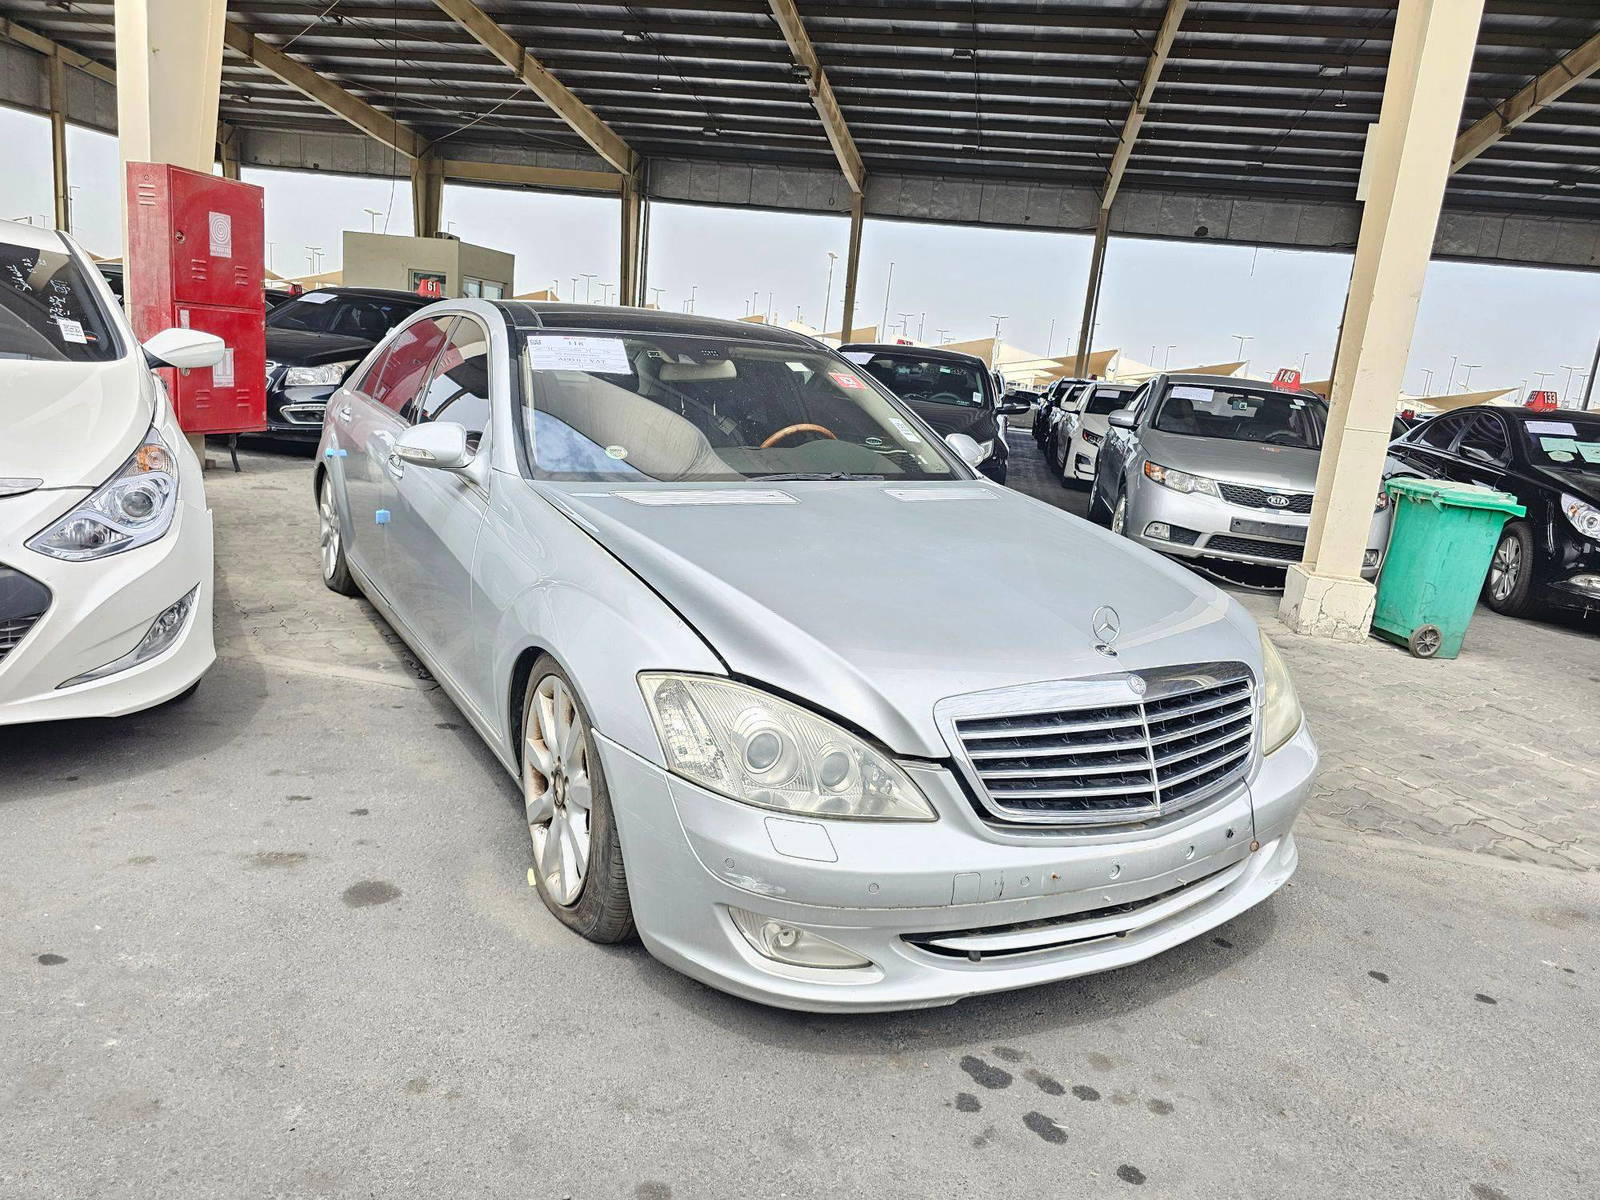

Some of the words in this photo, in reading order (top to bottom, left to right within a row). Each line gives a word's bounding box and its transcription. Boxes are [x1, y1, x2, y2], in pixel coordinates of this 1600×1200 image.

[427, 281, 437, 292] 61
[1277, 370, 1296, 384] 149
[1543, 391, 1556, 404] 133
[1270, 496, 1287, 505] KIA
